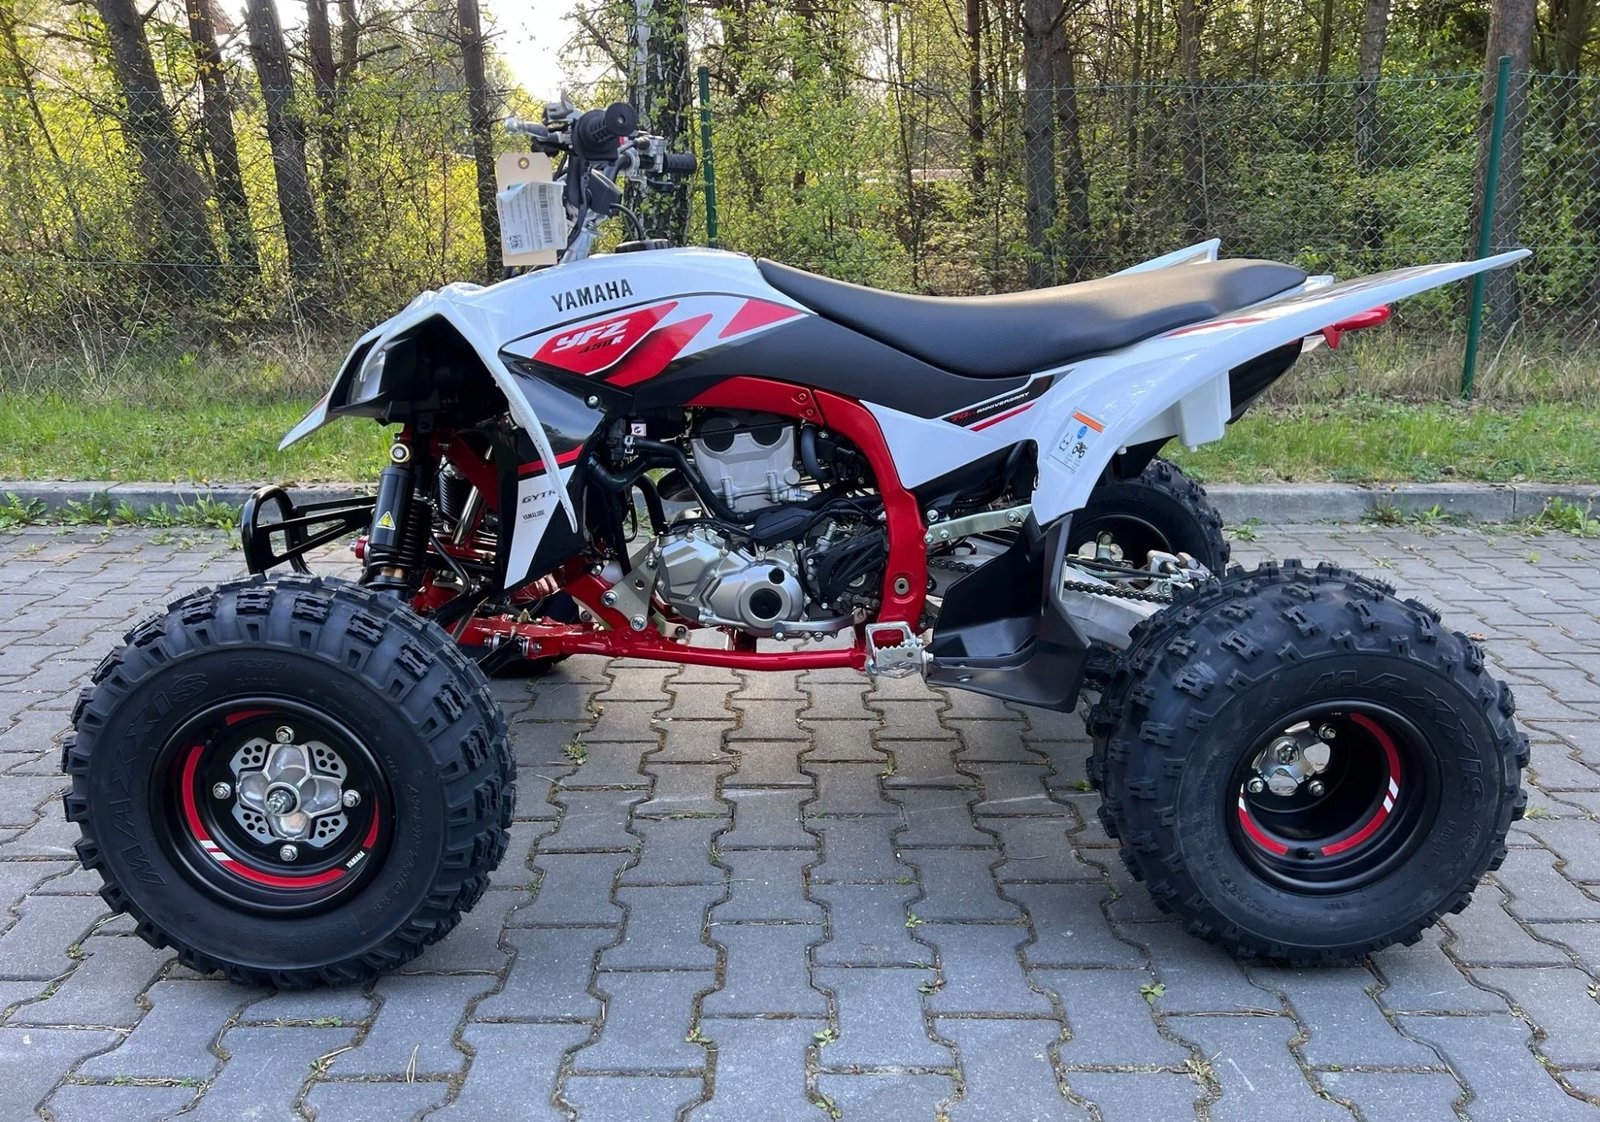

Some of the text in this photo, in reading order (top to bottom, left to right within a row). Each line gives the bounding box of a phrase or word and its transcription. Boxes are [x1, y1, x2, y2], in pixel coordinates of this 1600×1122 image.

[551, 278, 633, 312] YAMAHA
[551, 318, 631, 353] YFZ
[1304, 669, 1484, 811] MAXXIS
[109, 672, 209, 886] MAXXIS
[345, 850, 366, 869] YAMAHA
